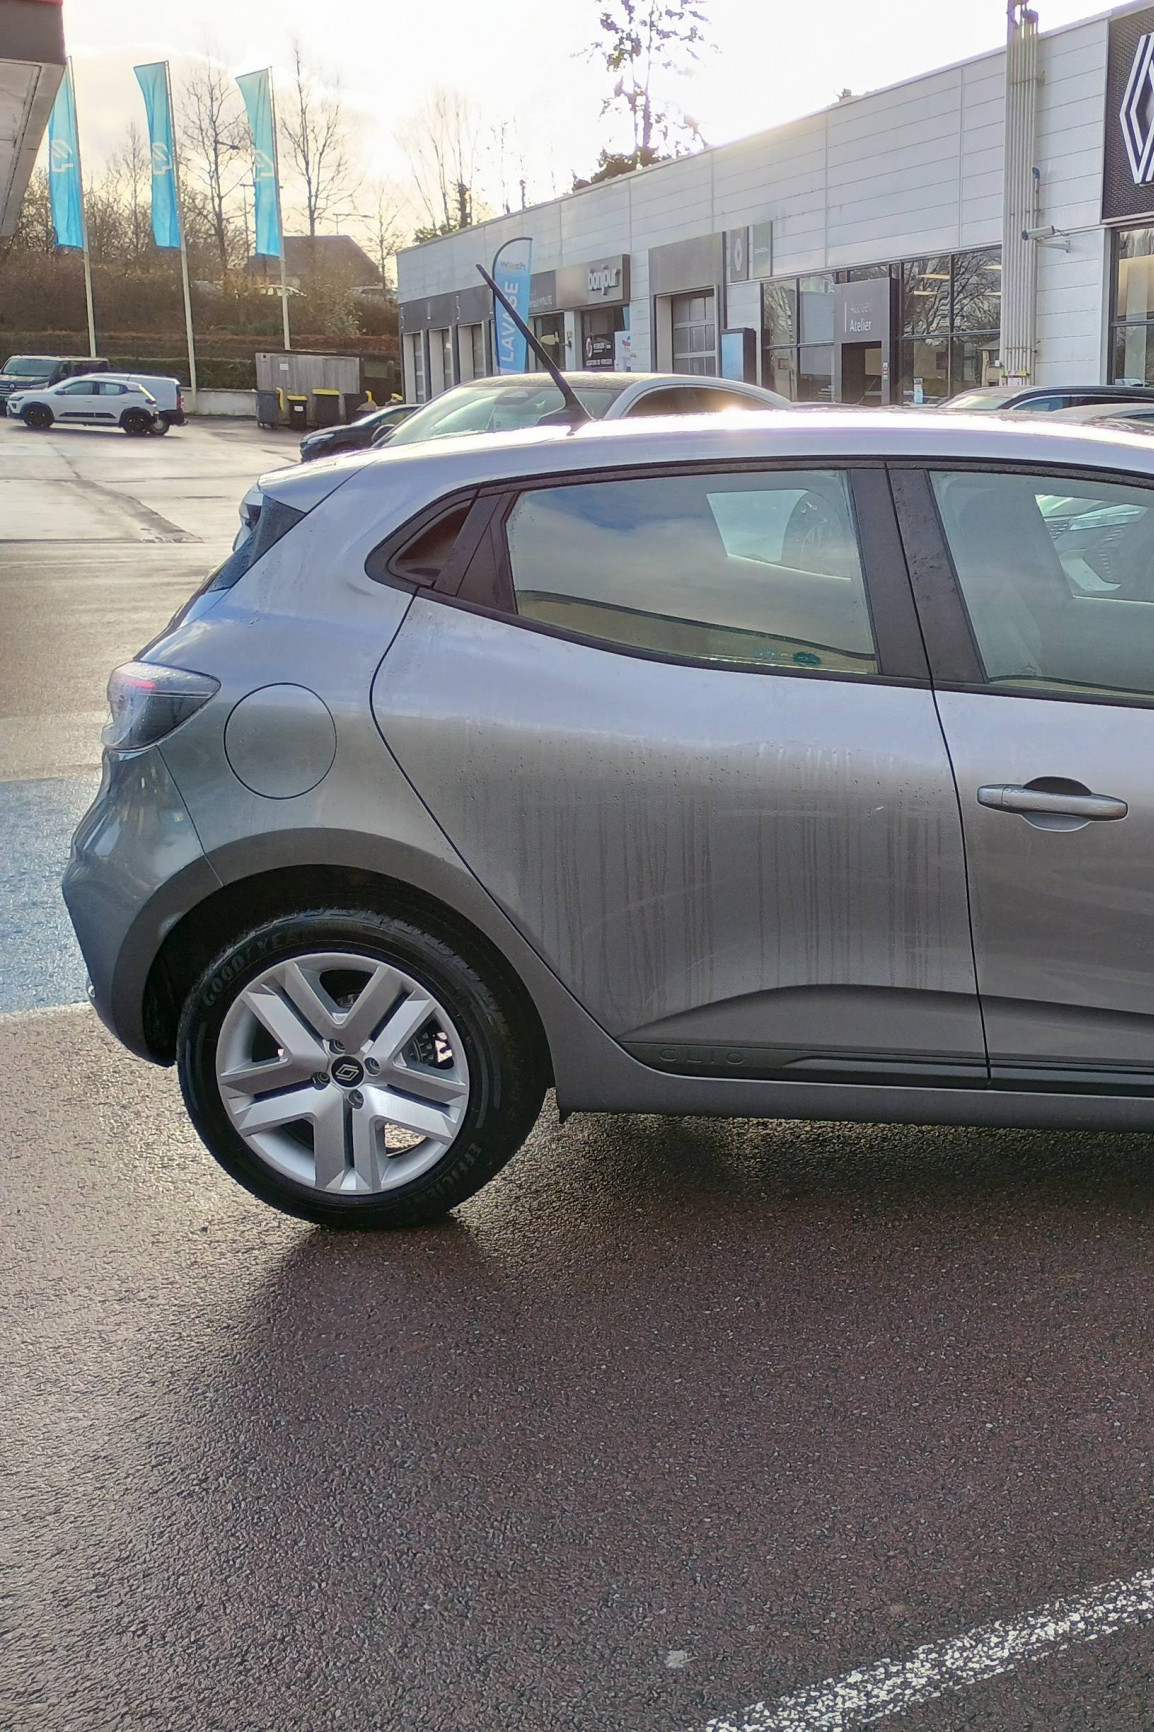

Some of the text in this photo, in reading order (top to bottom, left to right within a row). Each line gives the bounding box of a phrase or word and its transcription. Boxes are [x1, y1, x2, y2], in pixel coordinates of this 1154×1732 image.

[588, 264, 619, 295] bonjour
[849, 318, 873, 332] Atelier
[658, 1048, 745, 1065] CLIO
